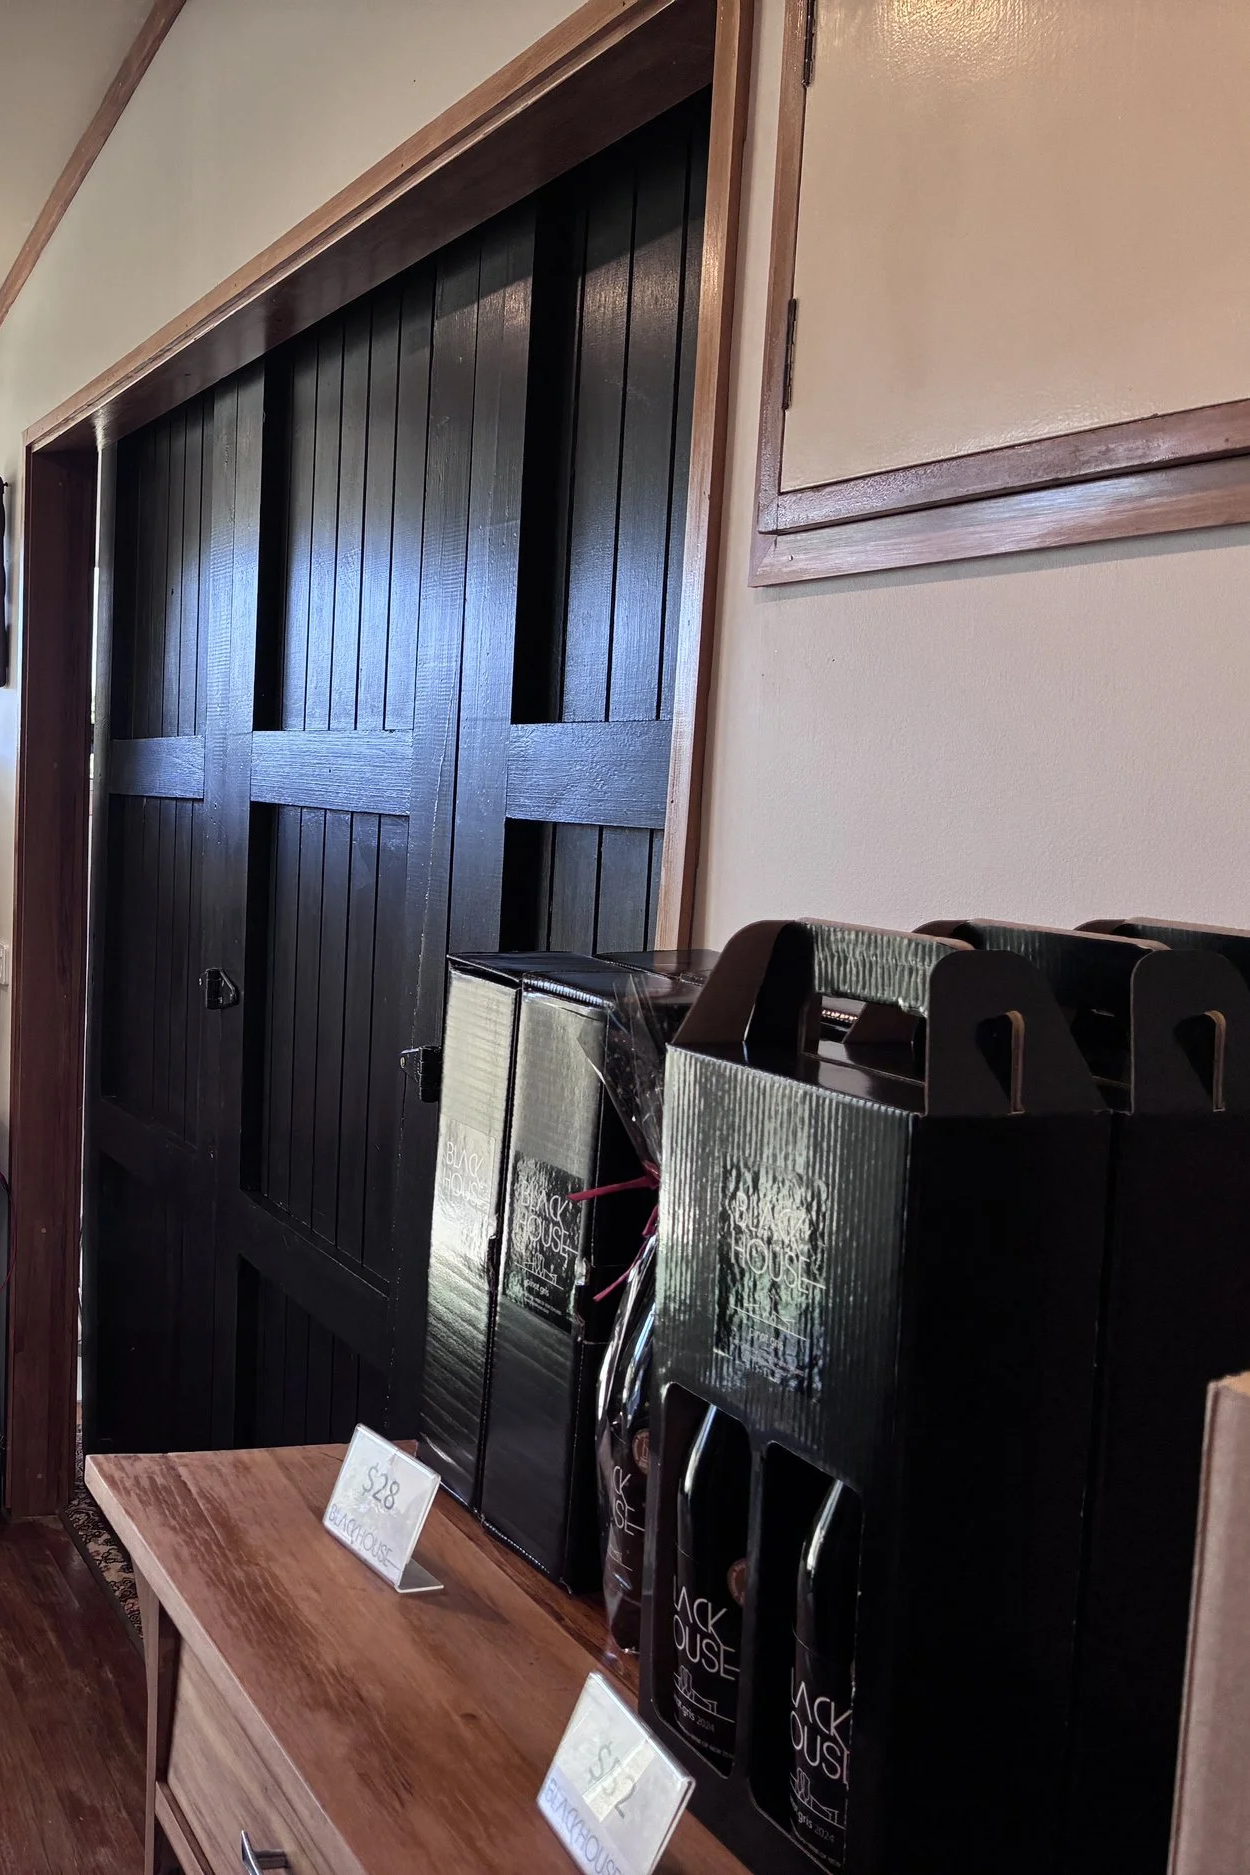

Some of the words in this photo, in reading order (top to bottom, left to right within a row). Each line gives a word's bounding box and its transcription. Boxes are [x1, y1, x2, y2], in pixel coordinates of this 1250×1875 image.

[446, 1141, 485, 1182] BLACK
[516, 1208, 579, 1258] HOUSE
[519, 1180, 569, 1228] BLACK
[731, 1231, 826, 1294] HOUSE
[361, 1462, 401, 1510] $28
[328, 1503, 402, 1572] BLACKHOUSE
[673, 1575, 727, 1642] LACK
[673, 1614, 741, 1681] OUSE
[790, 1667, 852, 1745] LACK
[790, 1711, 850, 1792] OUS
[544, 1778, 623, 1875] BLACKHOUS
